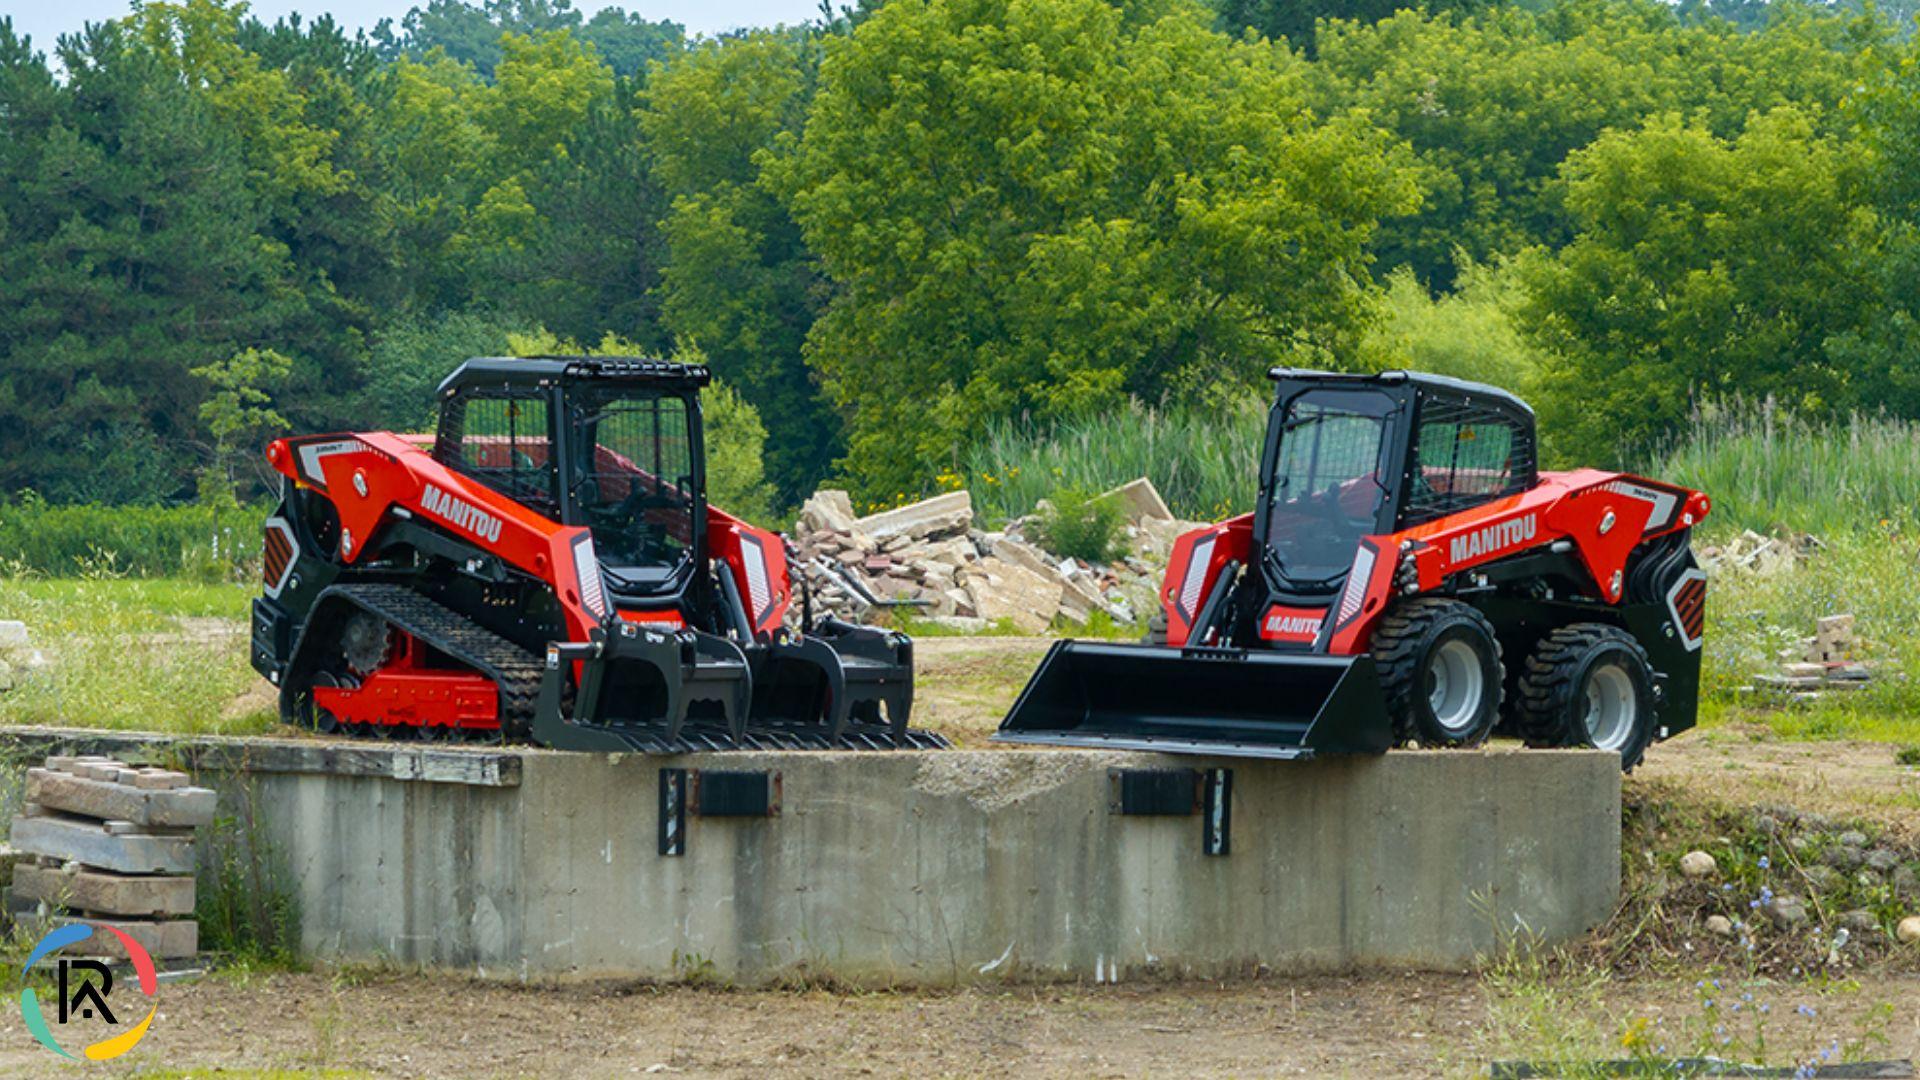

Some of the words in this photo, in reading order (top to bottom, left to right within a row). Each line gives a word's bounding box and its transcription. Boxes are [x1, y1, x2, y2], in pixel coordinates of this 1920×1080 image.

[420, 483, 503, 543] MANITOU
[1450, 512, 1537, 564] MANITOU
[1266, 616, 1322, 634] MANITO
